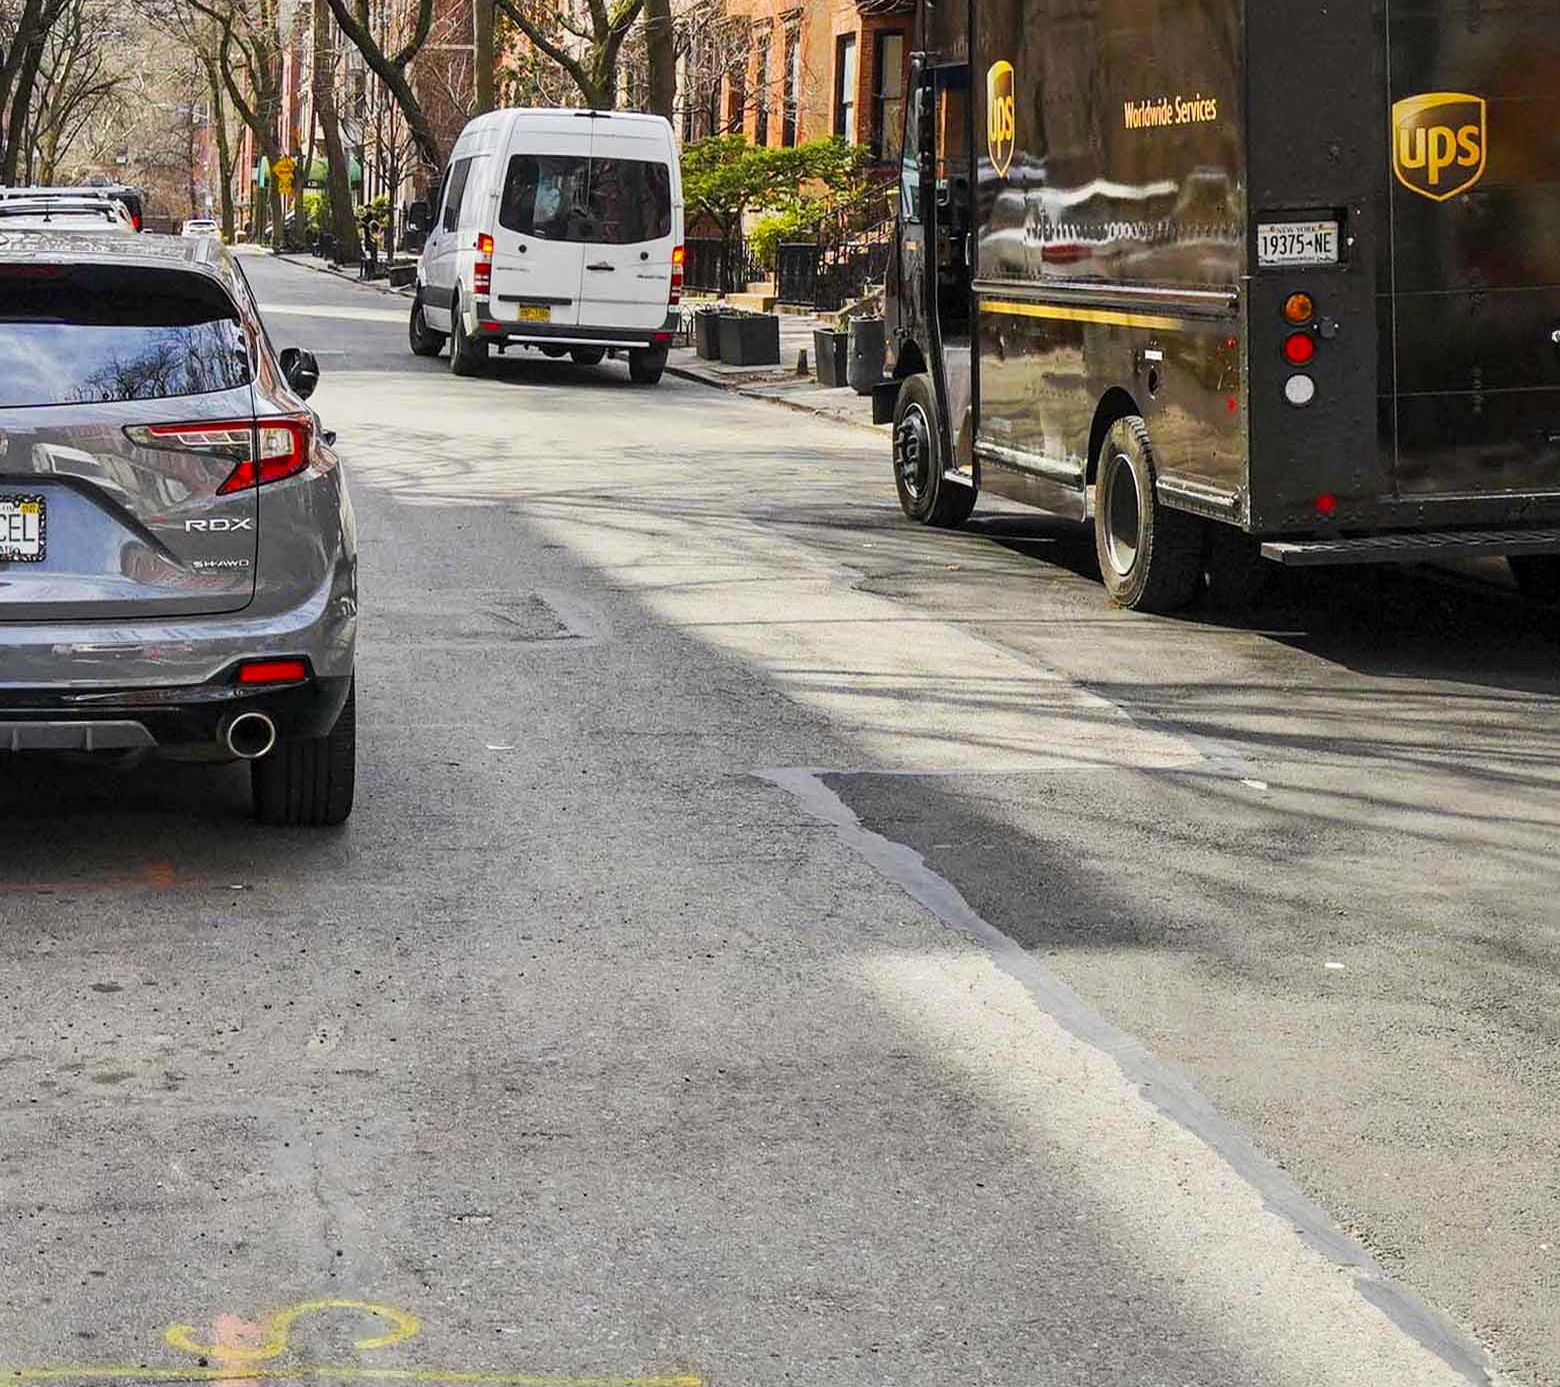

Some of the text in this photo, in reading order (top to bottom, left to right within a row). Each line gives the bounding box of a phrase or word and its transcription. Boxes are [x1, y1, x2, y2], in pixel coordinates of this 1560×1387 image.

[990, 95, 1013, 159] ups
[1124, 93, 1216, 129] Worldwide Services
[1400, 125, 1480, 184] ups
[185, 517, 253, 532] RDX
